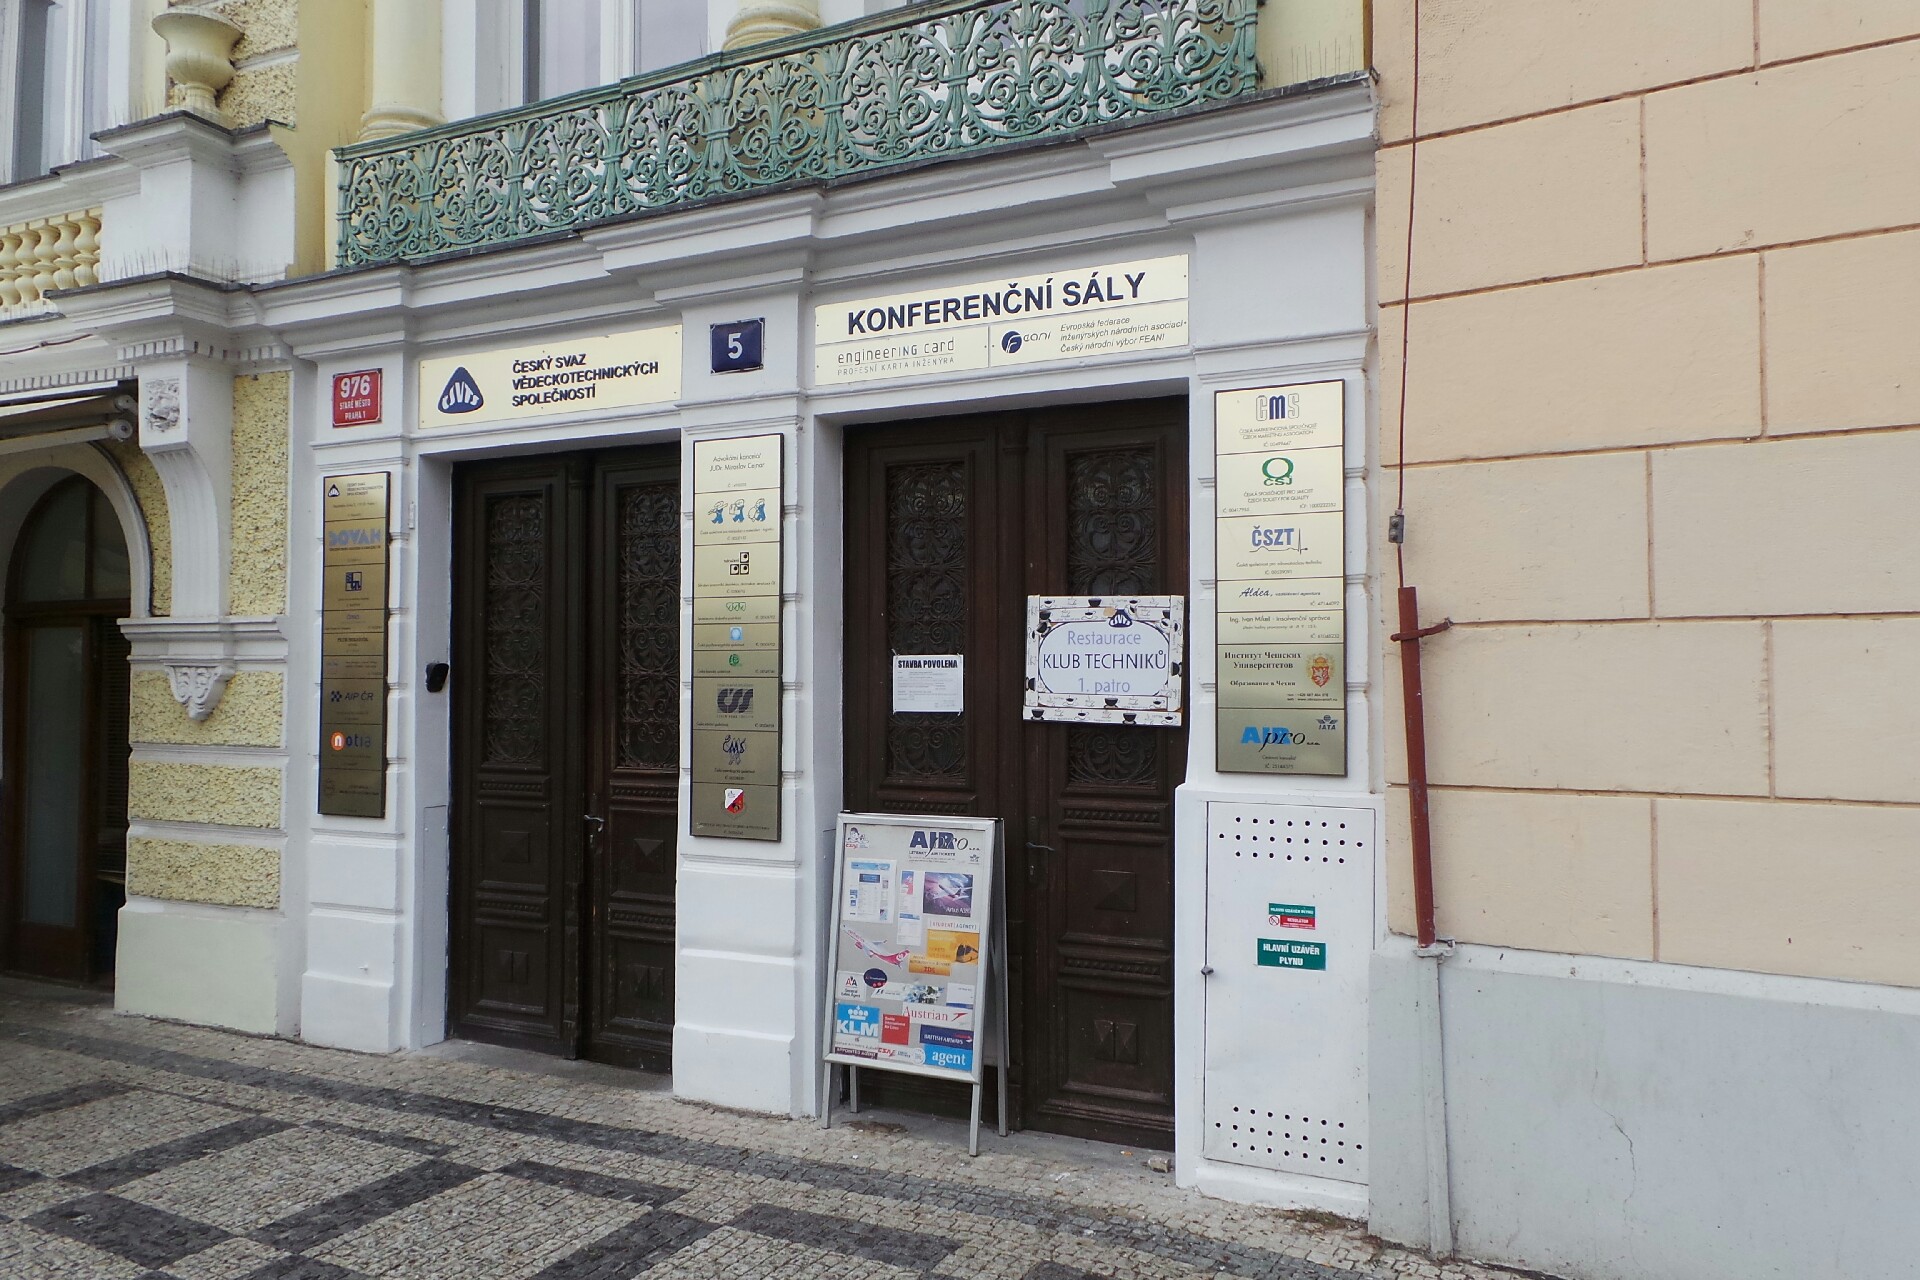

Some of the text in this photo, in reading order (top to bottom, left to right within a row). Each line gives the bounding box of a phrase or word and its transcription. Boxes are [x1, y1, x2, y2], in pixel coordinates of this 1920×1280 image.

[848, 272, 1146, 334] KONFERENČNÍ SÁLY
[1060, 327, 1109, 342] inženýrských
[1111, 322, 1149, 335] národních
[1061, 316, 1131, 332] Evropská federace
[727, 332, 743, 360] 5
[924, 336, 954, 354] card
[1060, 342, 1084, 353] Český
[1085, 340, 1114, 350] národní
[1116, 337, 1137, 347] výbor
[512, 353, 587, 374] ČESKÝ SVAZ
[881, 361, 909, 371] KARTA
[512, 360, 659, 390] VĚDECKOTECHNICKÝCH
[340, 375, 370, 398] 976
[512, 383, 596, 407] SPOLEČNOSTÍ
[354, 398, 371, 408] MĚSTO
[345, 411, 362, 420] PRAHA
[1251, 525, 1295, 547] ČSZT
[1067, 630, 1141, 646] Restaurace
[898, 659, 958, 668] STAVBA POVOLENA
[1043, 649, 1167, 669] KLUB TECHNIKŮ
[1078, 678, 1130, 694] 1. patro
[1263, 943, 1320, 955] HLAVNÍ UZÁVĚR
[1279, 956, 1303, 966] PLYNU
[903, 1005, 948, 1022] Austrian
[837, 1019, 879, 1037] KLM
[923, 1033, 943, 1042] BRITISH
[932, 1049, 966, 1066] agent
